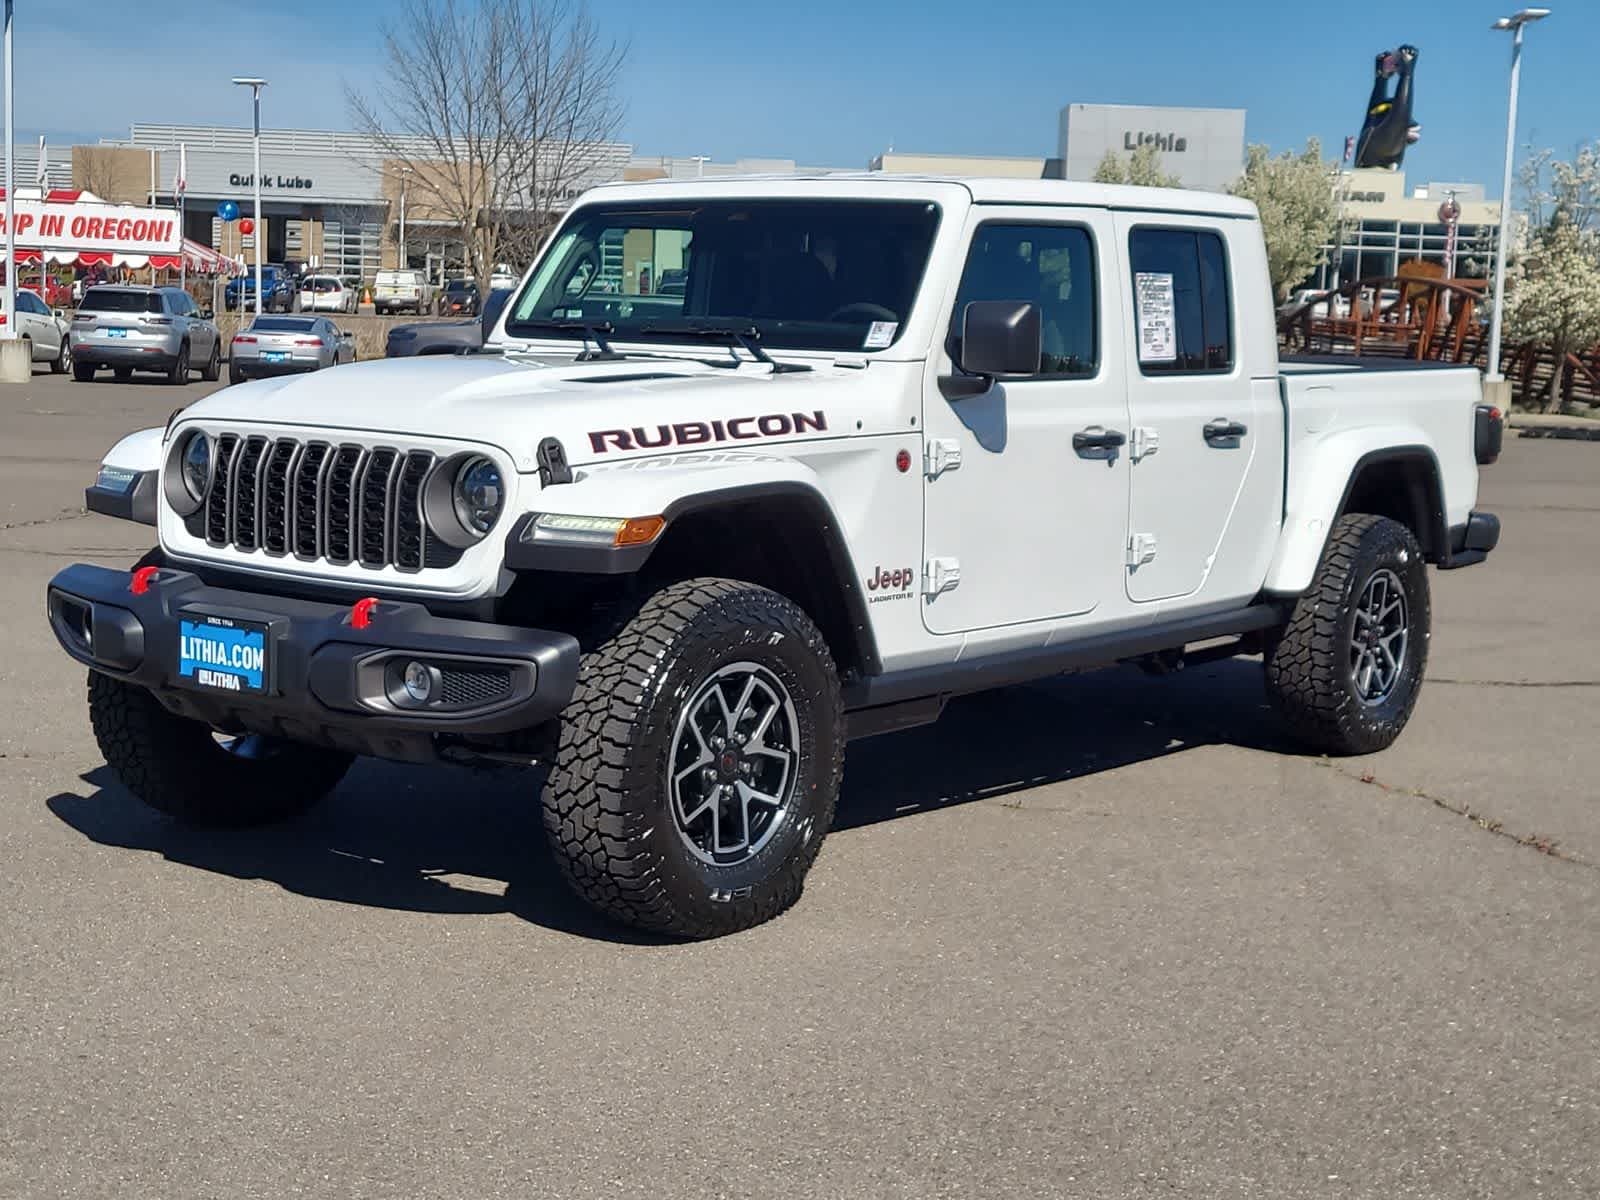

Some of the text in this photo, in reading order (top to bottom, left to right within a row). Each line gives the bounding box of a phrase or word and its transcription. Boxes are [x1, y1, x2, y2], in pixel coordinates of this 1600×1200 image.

[1124, 131, 1187, 152] Lithia
[277, 175, 313, 189] Lube
[39, 214, 66, 237] IN
[71, 215, 174, 242] OREGON!
[587, 410, 828, 453] RUBICON
[867, 566, 914, 591] Jeep
[181, 635, 264, 672] LITHIA.COM
[207, 671, 241, 691] LITHIA
